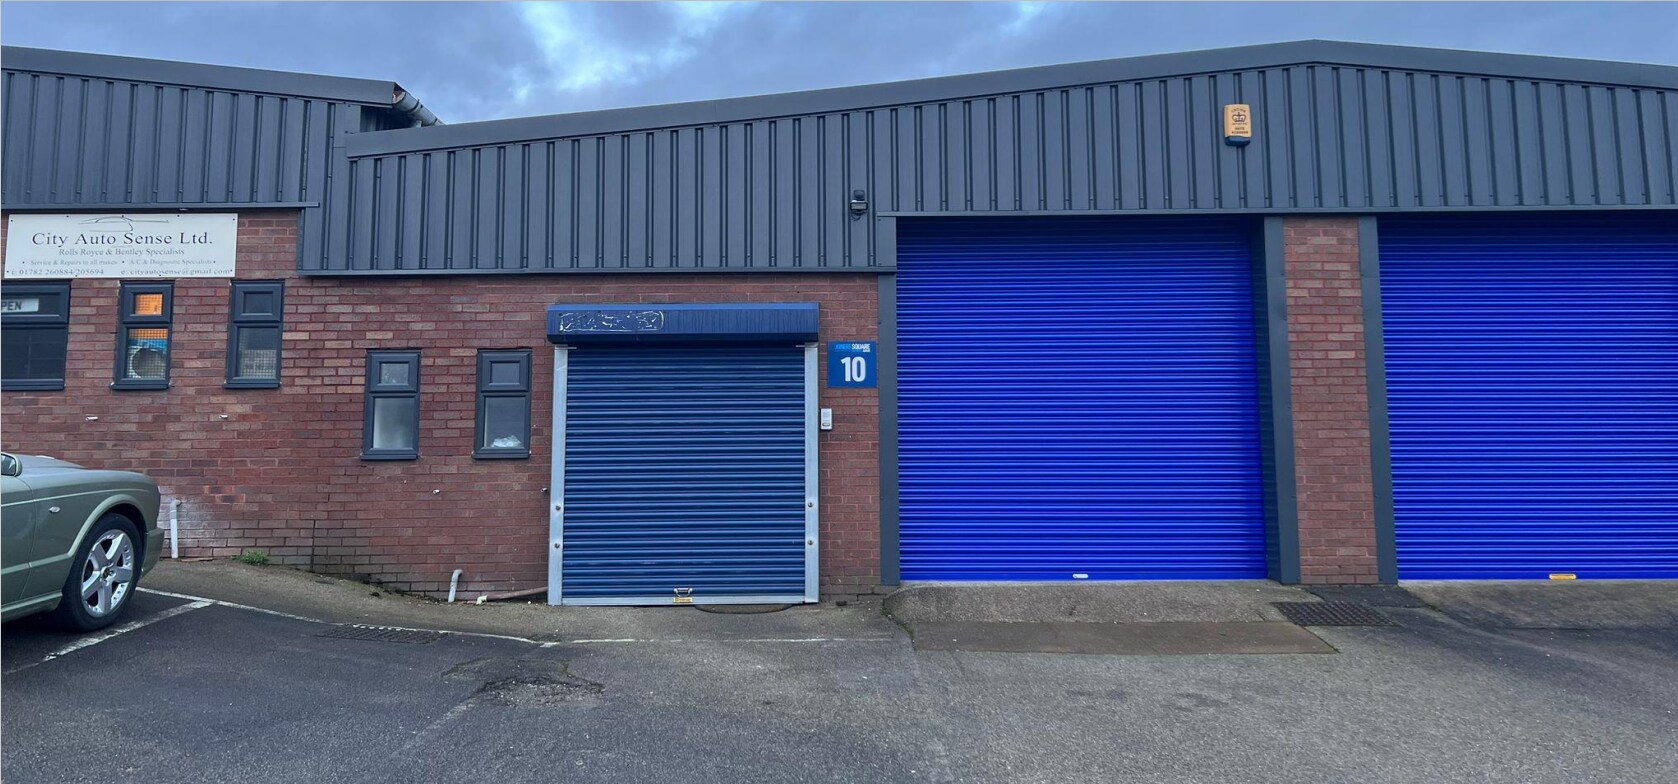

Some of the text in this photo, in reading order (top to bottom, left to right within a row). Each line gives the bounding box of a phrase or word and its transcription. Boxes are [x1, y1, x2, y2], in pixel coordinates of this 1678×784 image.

[32, 232, 213, 248] City Auto Sense Ltd.
[80, 249, 104, 257] Royce
[115, 248, 143, 256] Bentley
[145, 248, 185, 256] Specialists
[840, 356, 866, 382] 10
